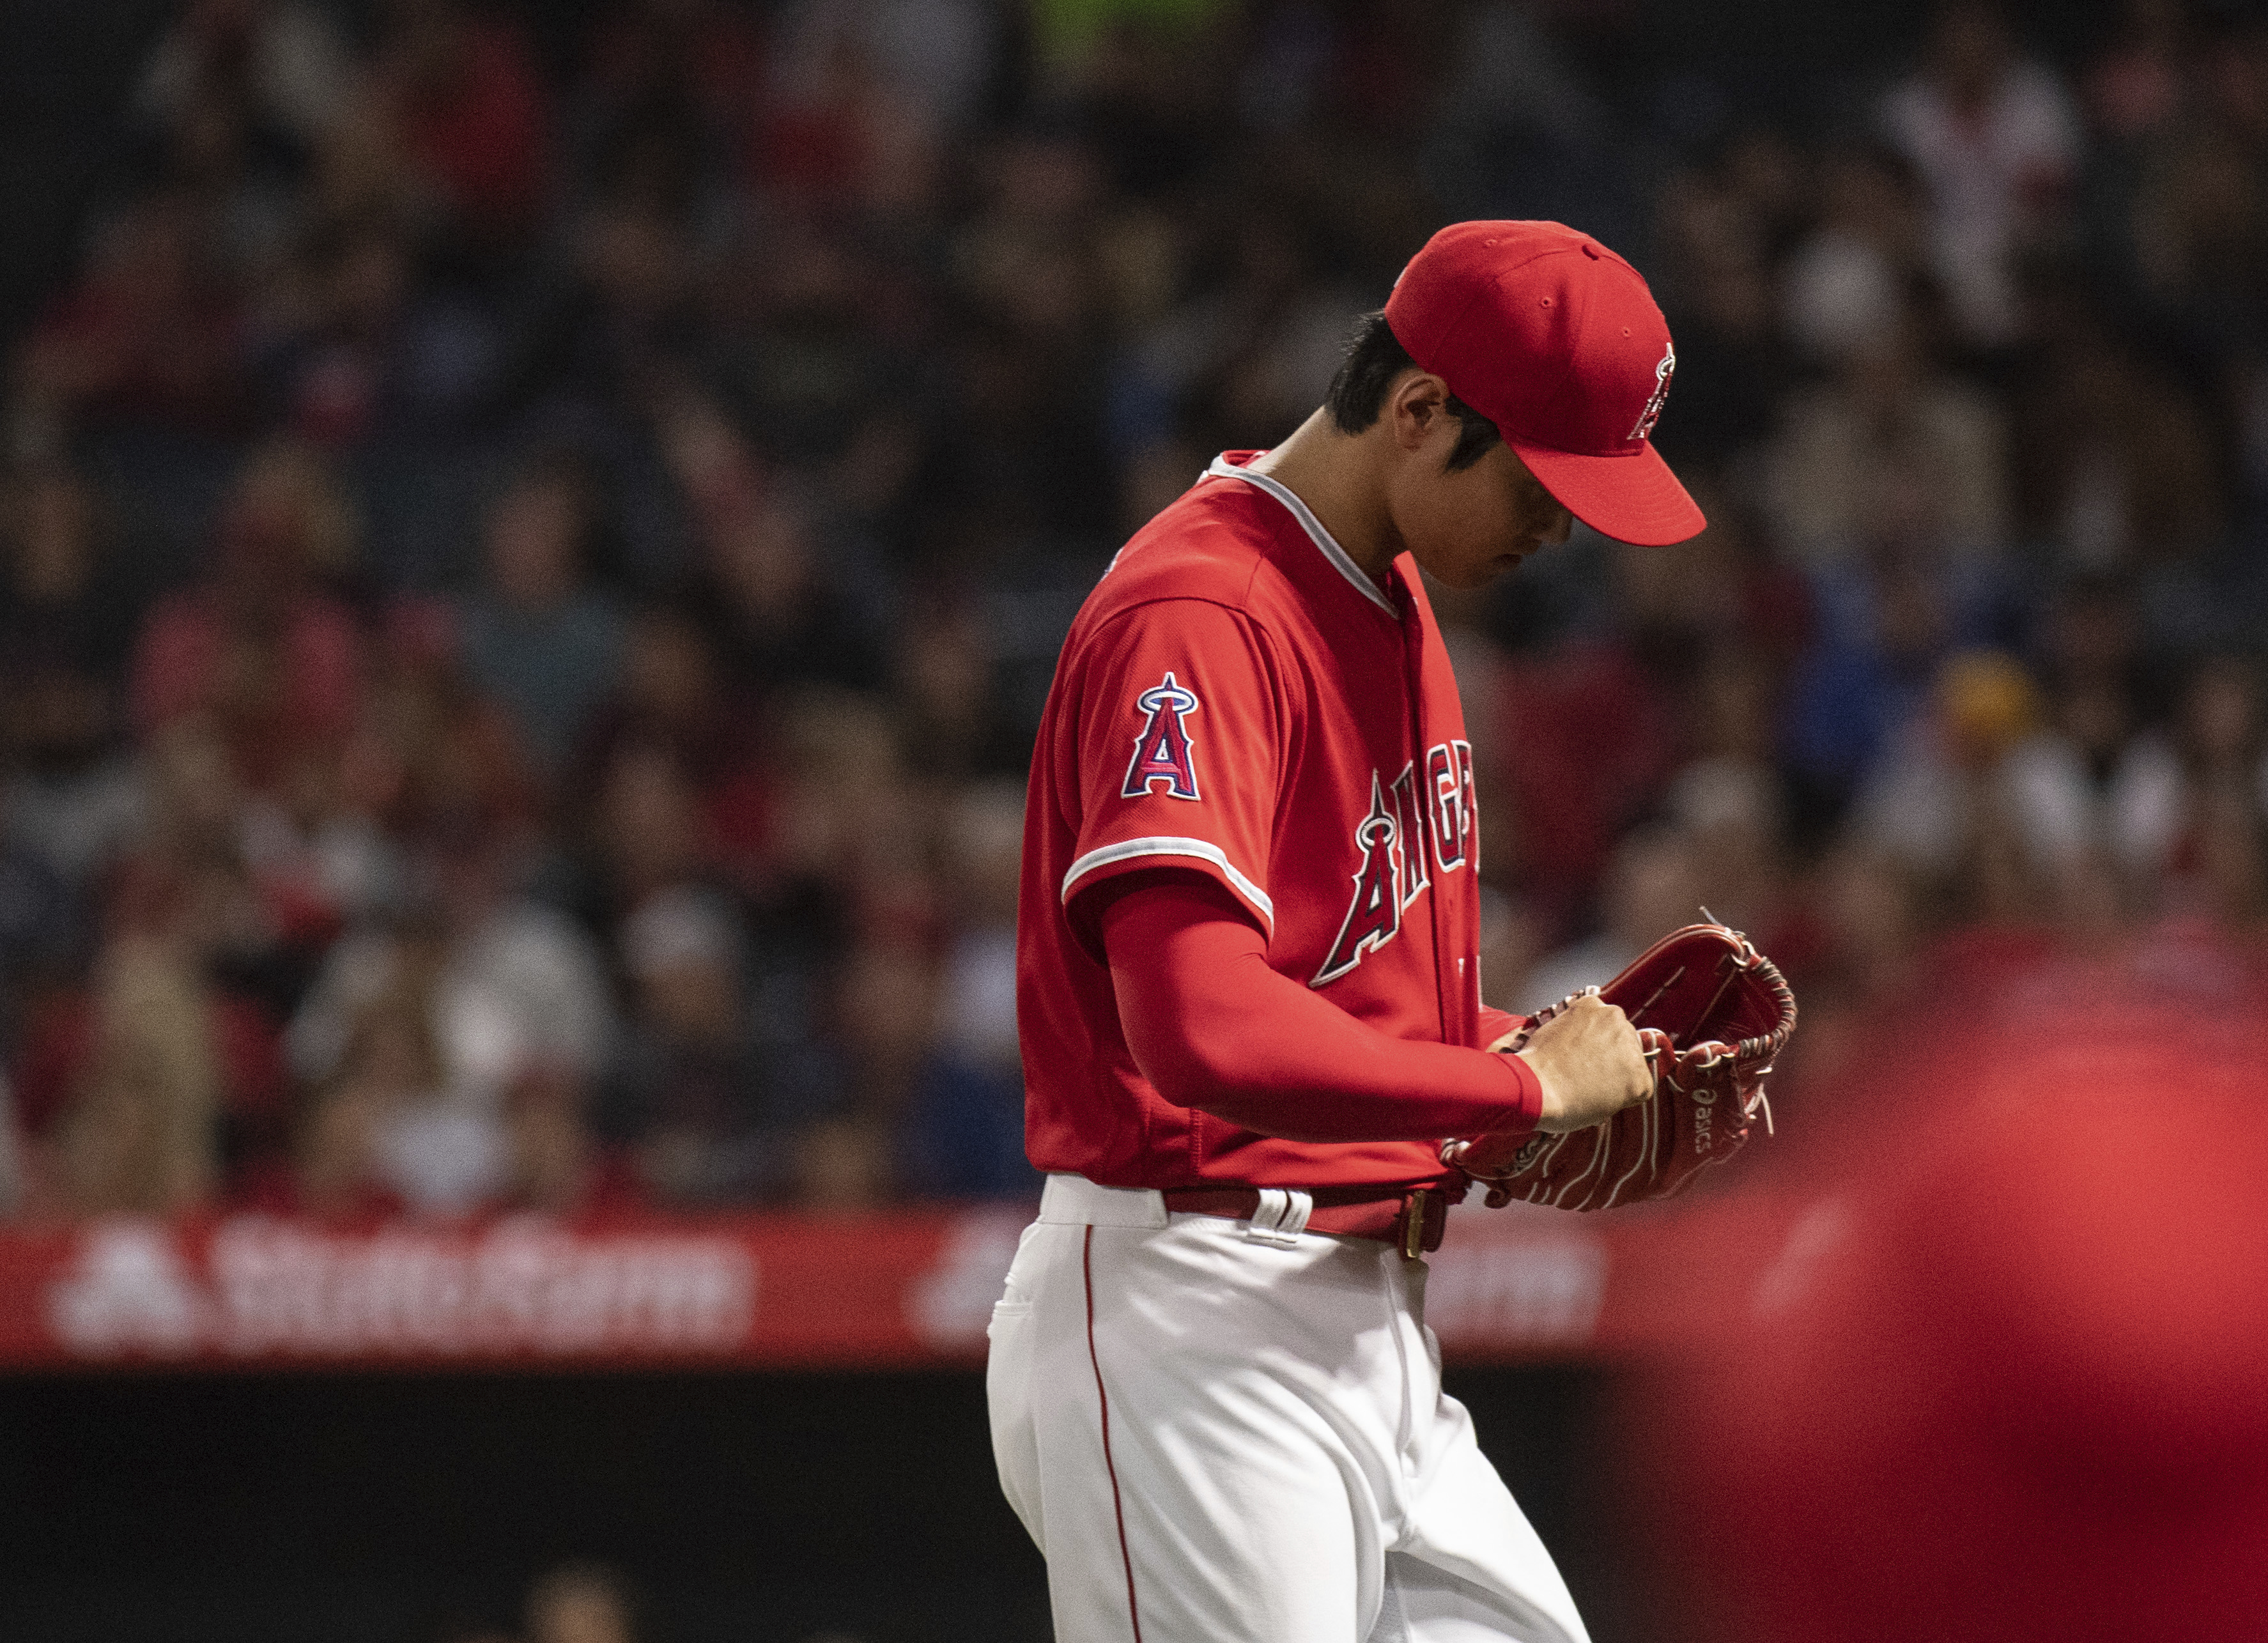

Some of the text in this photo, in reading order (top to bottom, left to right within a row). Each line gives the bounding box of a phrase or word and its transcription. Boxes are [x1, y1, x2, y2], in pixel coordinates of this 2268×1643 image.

[1121, 671, 1201, 801] A
[1309, 739, 1480, 988] ANGE
[1695, 1107, 1713, 1154] asics
